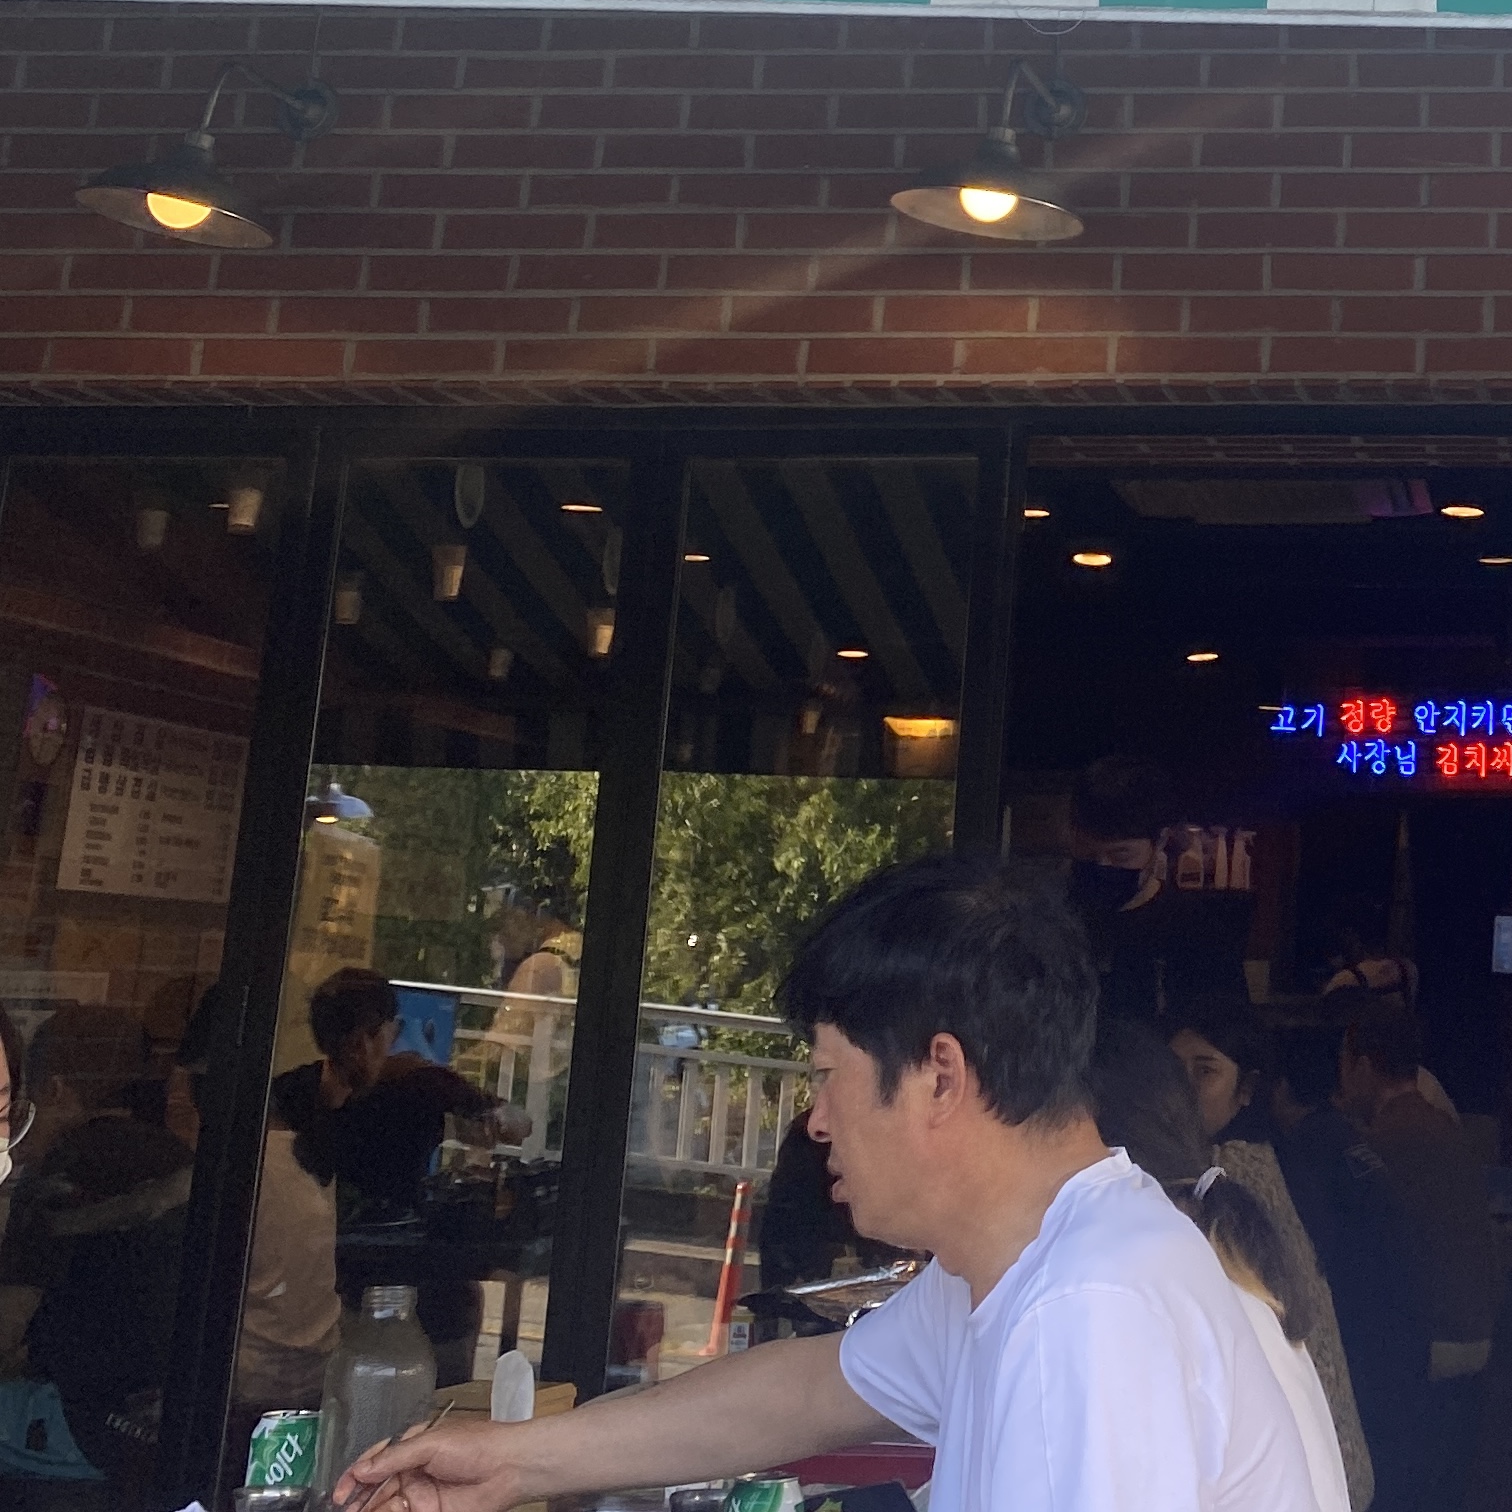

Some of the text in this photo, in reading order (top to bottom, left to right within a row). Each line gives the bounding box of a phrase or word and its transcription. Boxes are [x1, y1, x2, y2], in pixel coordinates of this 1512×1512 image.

[1269, 703, 1324, 738] 고기
[1339, 698, 1397, 734] 정량
[1336, 738, 1416, 776] 사장님
[264, 1431, 304, 1486] 이다
